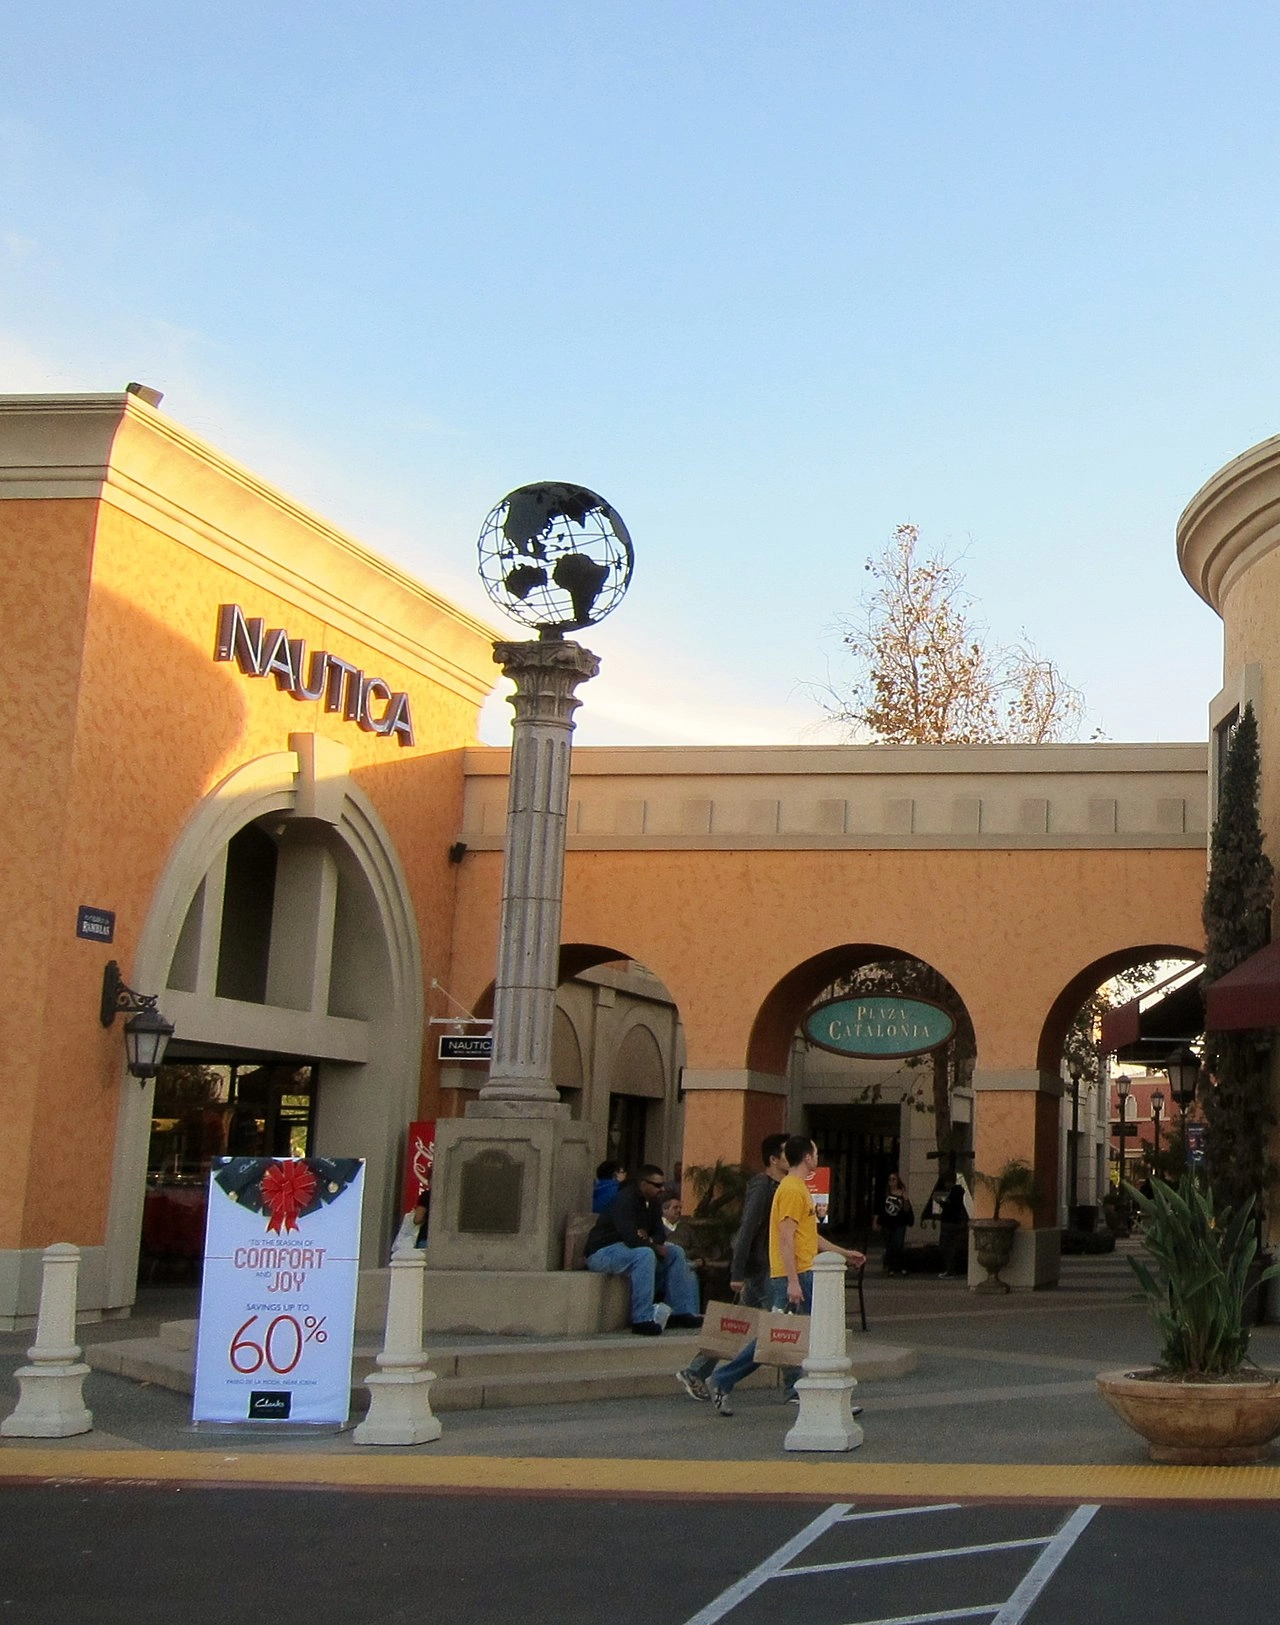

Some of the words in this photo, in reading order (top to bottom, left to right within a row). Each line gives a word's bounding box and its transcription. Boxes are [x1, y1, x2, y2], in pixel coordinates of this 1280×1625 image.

[213, 603, 415, 747] NAUTICA
[857, 1006, 908, 1020] PLAZA
[829, 1020, 929, 1040] CATALONIA
[448, 1041, 492, 1050] NAUTIC
[304, 1239, 314, 1247] OF
[234, 1247, 326, 1269] COMFORT
[267, 1271, 305, 1292] JOY
[246, 1303, 281, 1311] SAVINGS
[255, 1398, 285, 1408] Clarks
